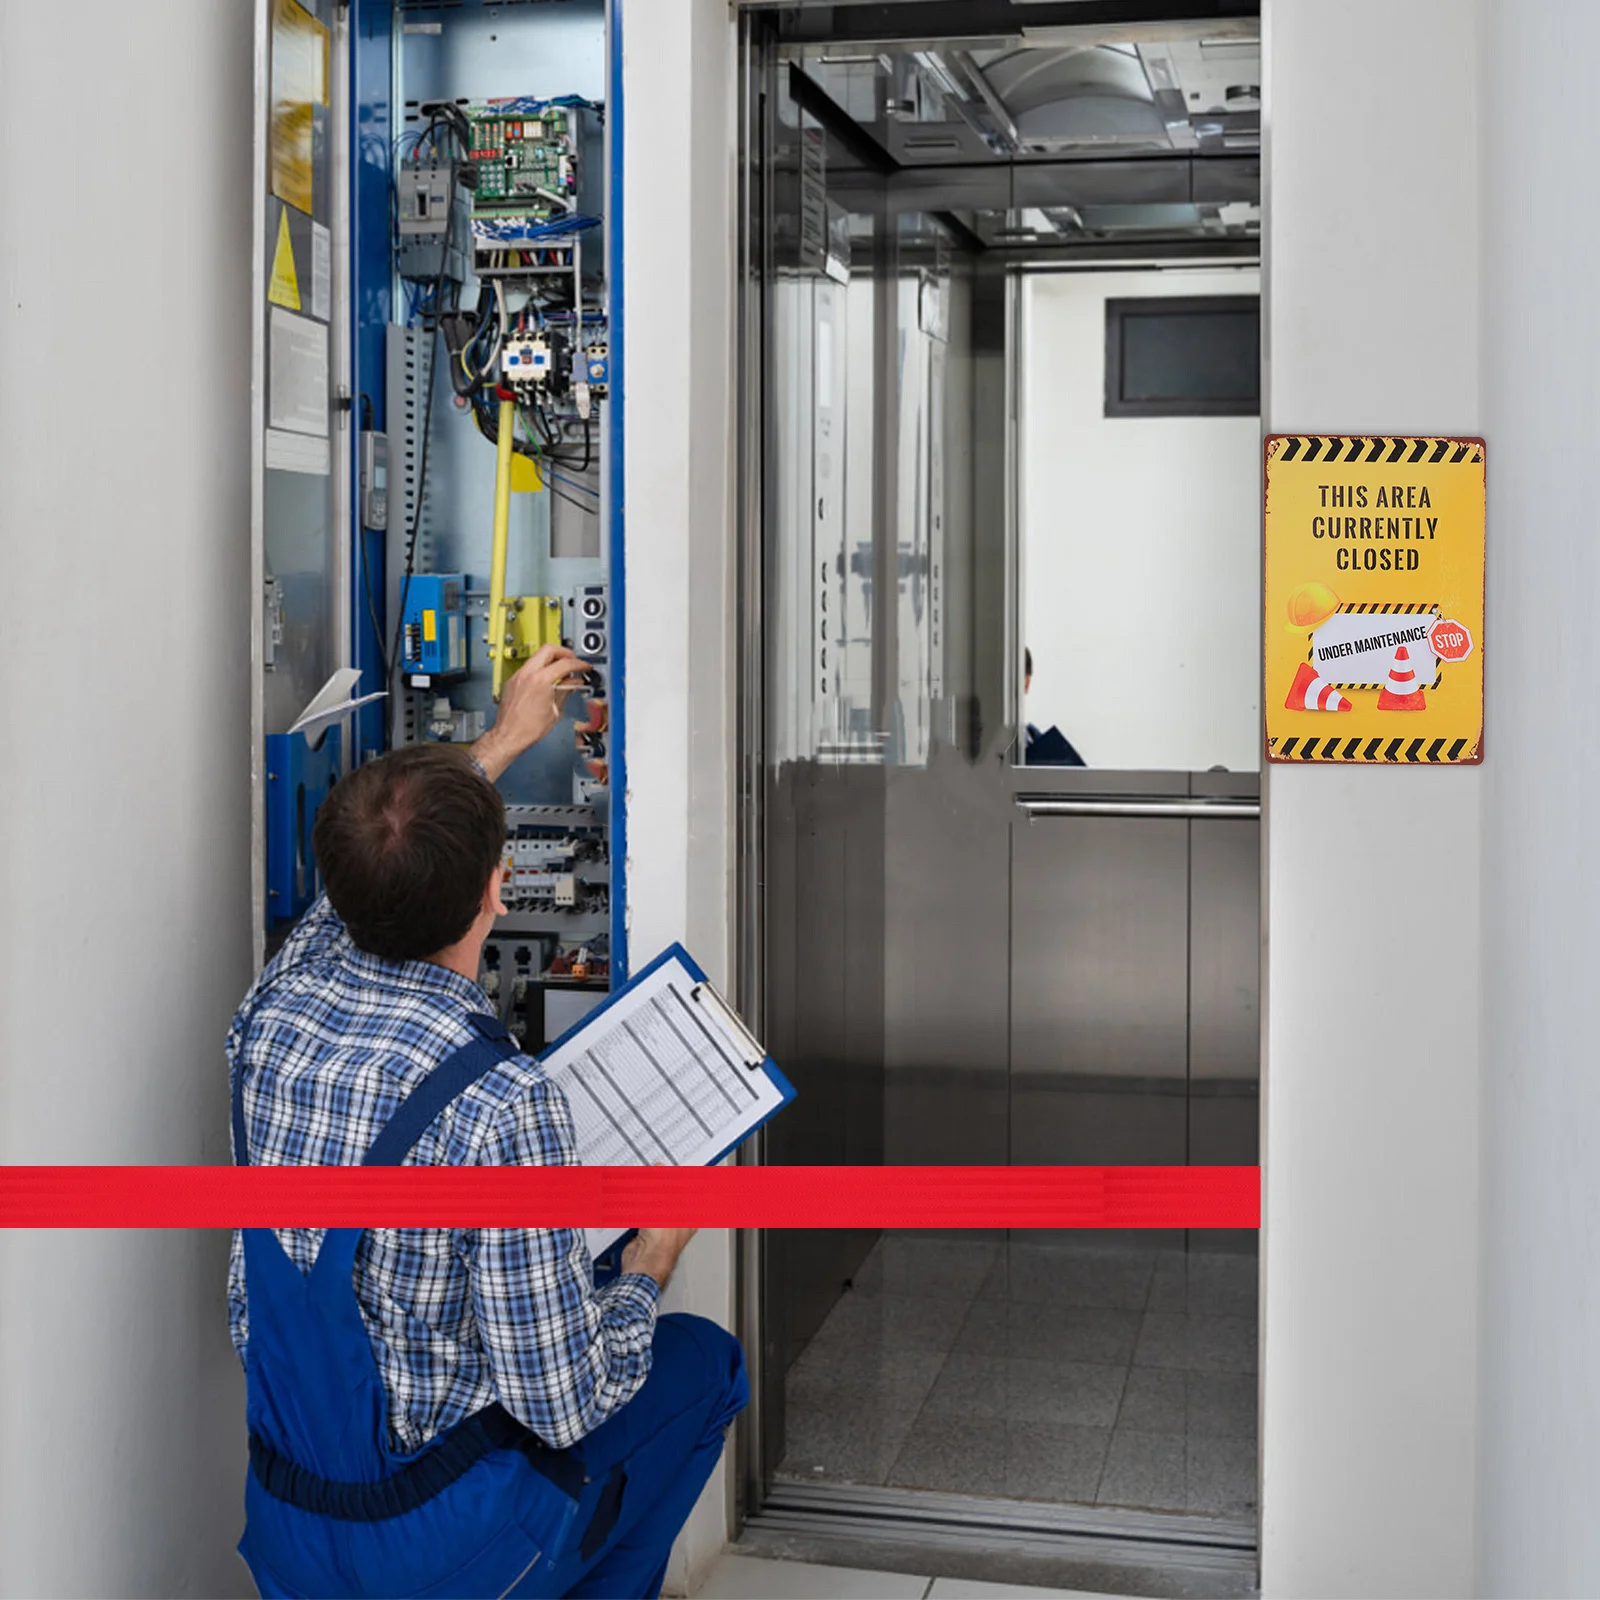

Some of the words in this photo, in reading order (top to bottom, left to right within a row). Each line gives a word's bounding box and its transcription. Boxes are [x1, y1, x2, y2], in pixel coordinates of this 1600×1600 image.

[1318, 485, 1368, 508] THIS
[1376, 486, 1431, 508] AREA
[1312, 516, 1438, 539] CURRENTLY
[1336, 548, 1419, 571] CLOSED
[1318, 641, 1353, 662] UNDER
[1354, 625, 1428, 654] MAINTENANCE
[1435, 632, 1464, 649] STOP
